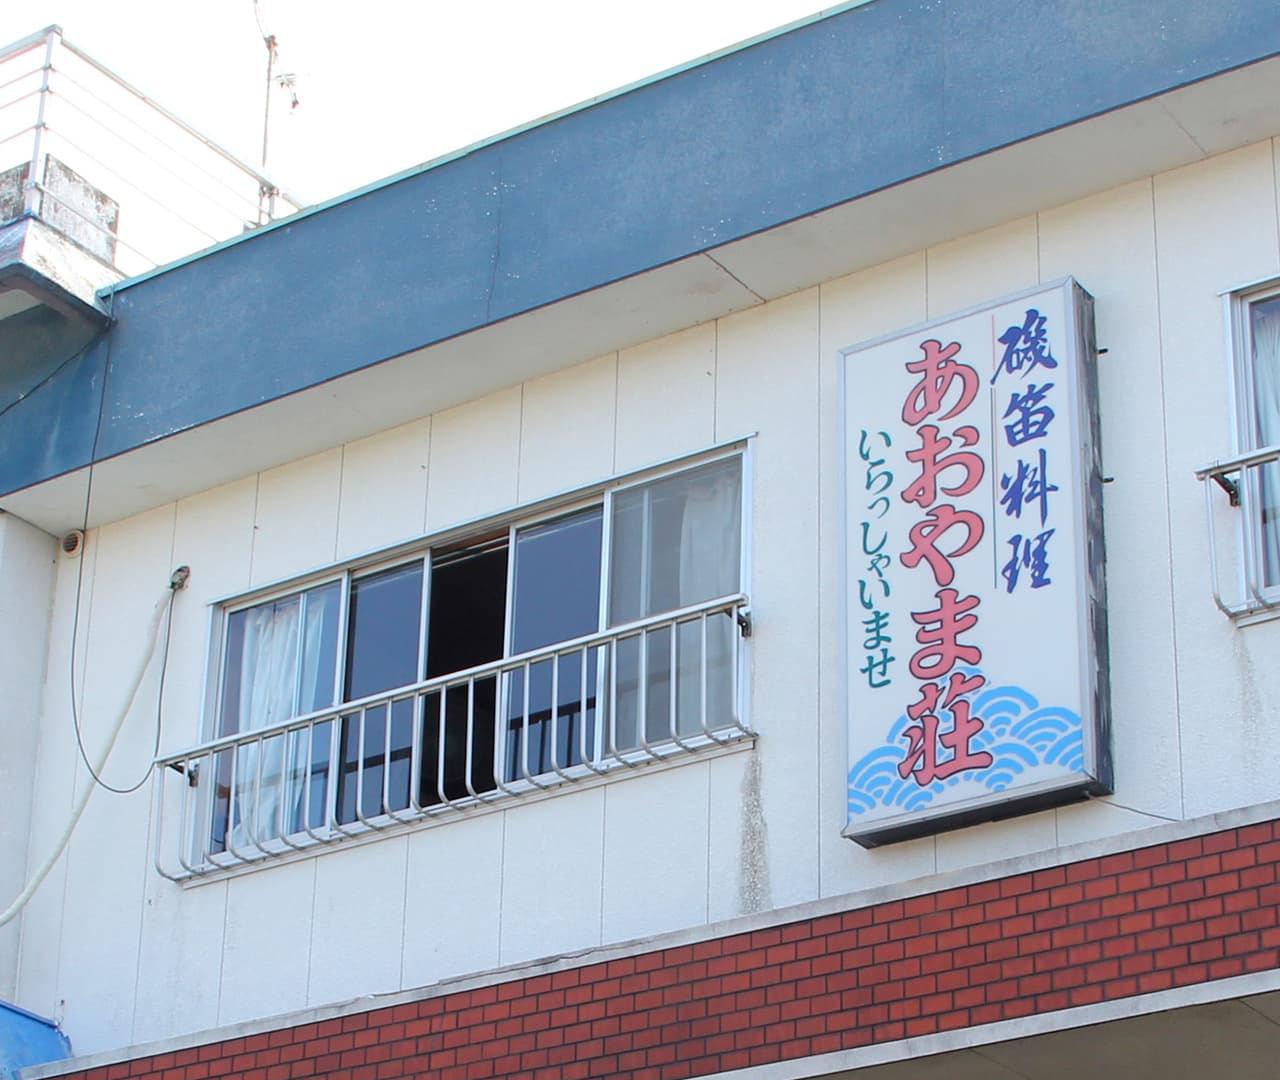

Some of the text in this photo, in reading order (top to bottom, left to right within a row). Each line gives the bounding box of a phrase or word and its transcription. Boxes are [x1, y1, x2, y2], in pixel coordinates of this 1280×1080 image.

[858, 428, 897, 689] いらっしゃいませ
[897, 338, 994, 787] あおやま荘
[991, 308, 1059, 594] 磯笛料理
